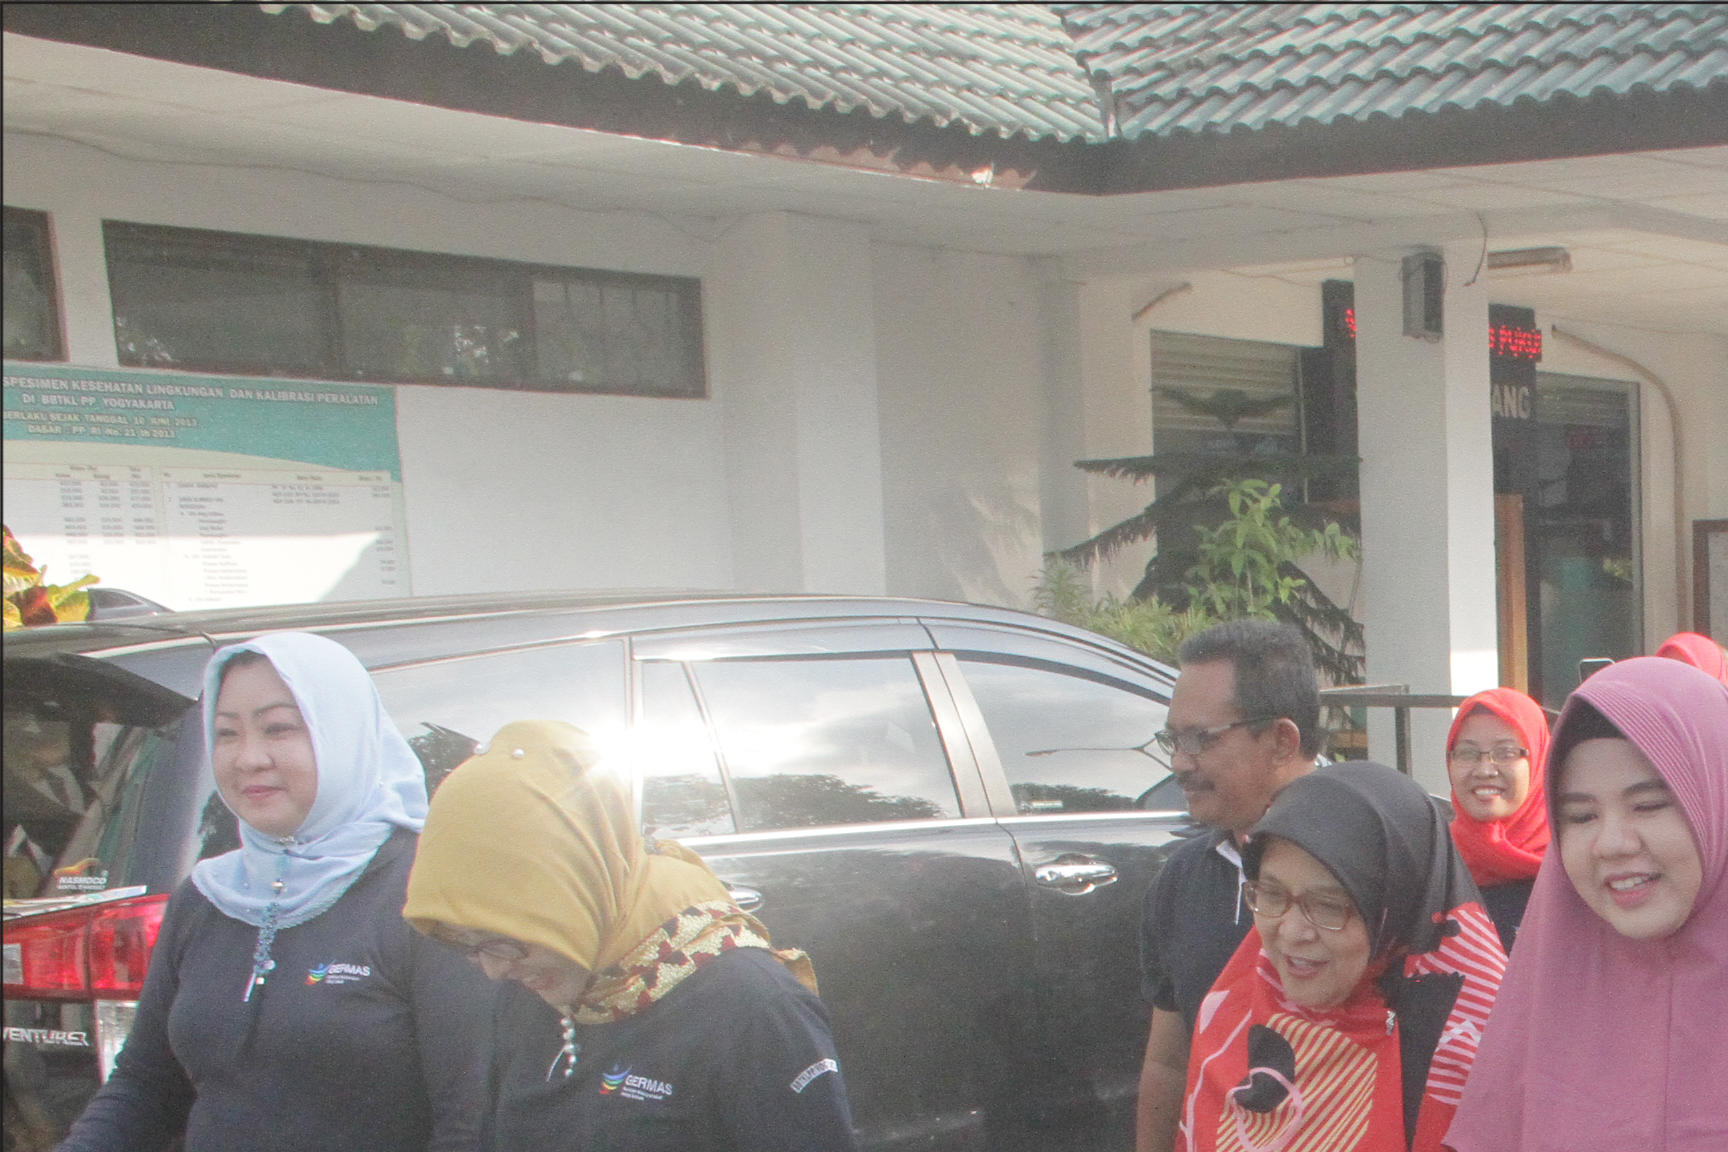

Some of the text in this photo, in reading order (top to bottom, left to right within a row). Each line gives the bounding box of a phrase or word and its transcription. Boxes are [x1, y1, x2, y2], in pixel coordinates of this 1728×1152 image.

[3, 376, 378, 405] SPESIMEN KESEHATAN LINGKUNGAN DAN KALIBRASI PERALATAN
[22, 393, 174, 410] DI BBTKL PP YOGYAKARTA
[85, 413, 129, 425] TANGGAL
[625, 1074, 673, 1096] GERMAS
